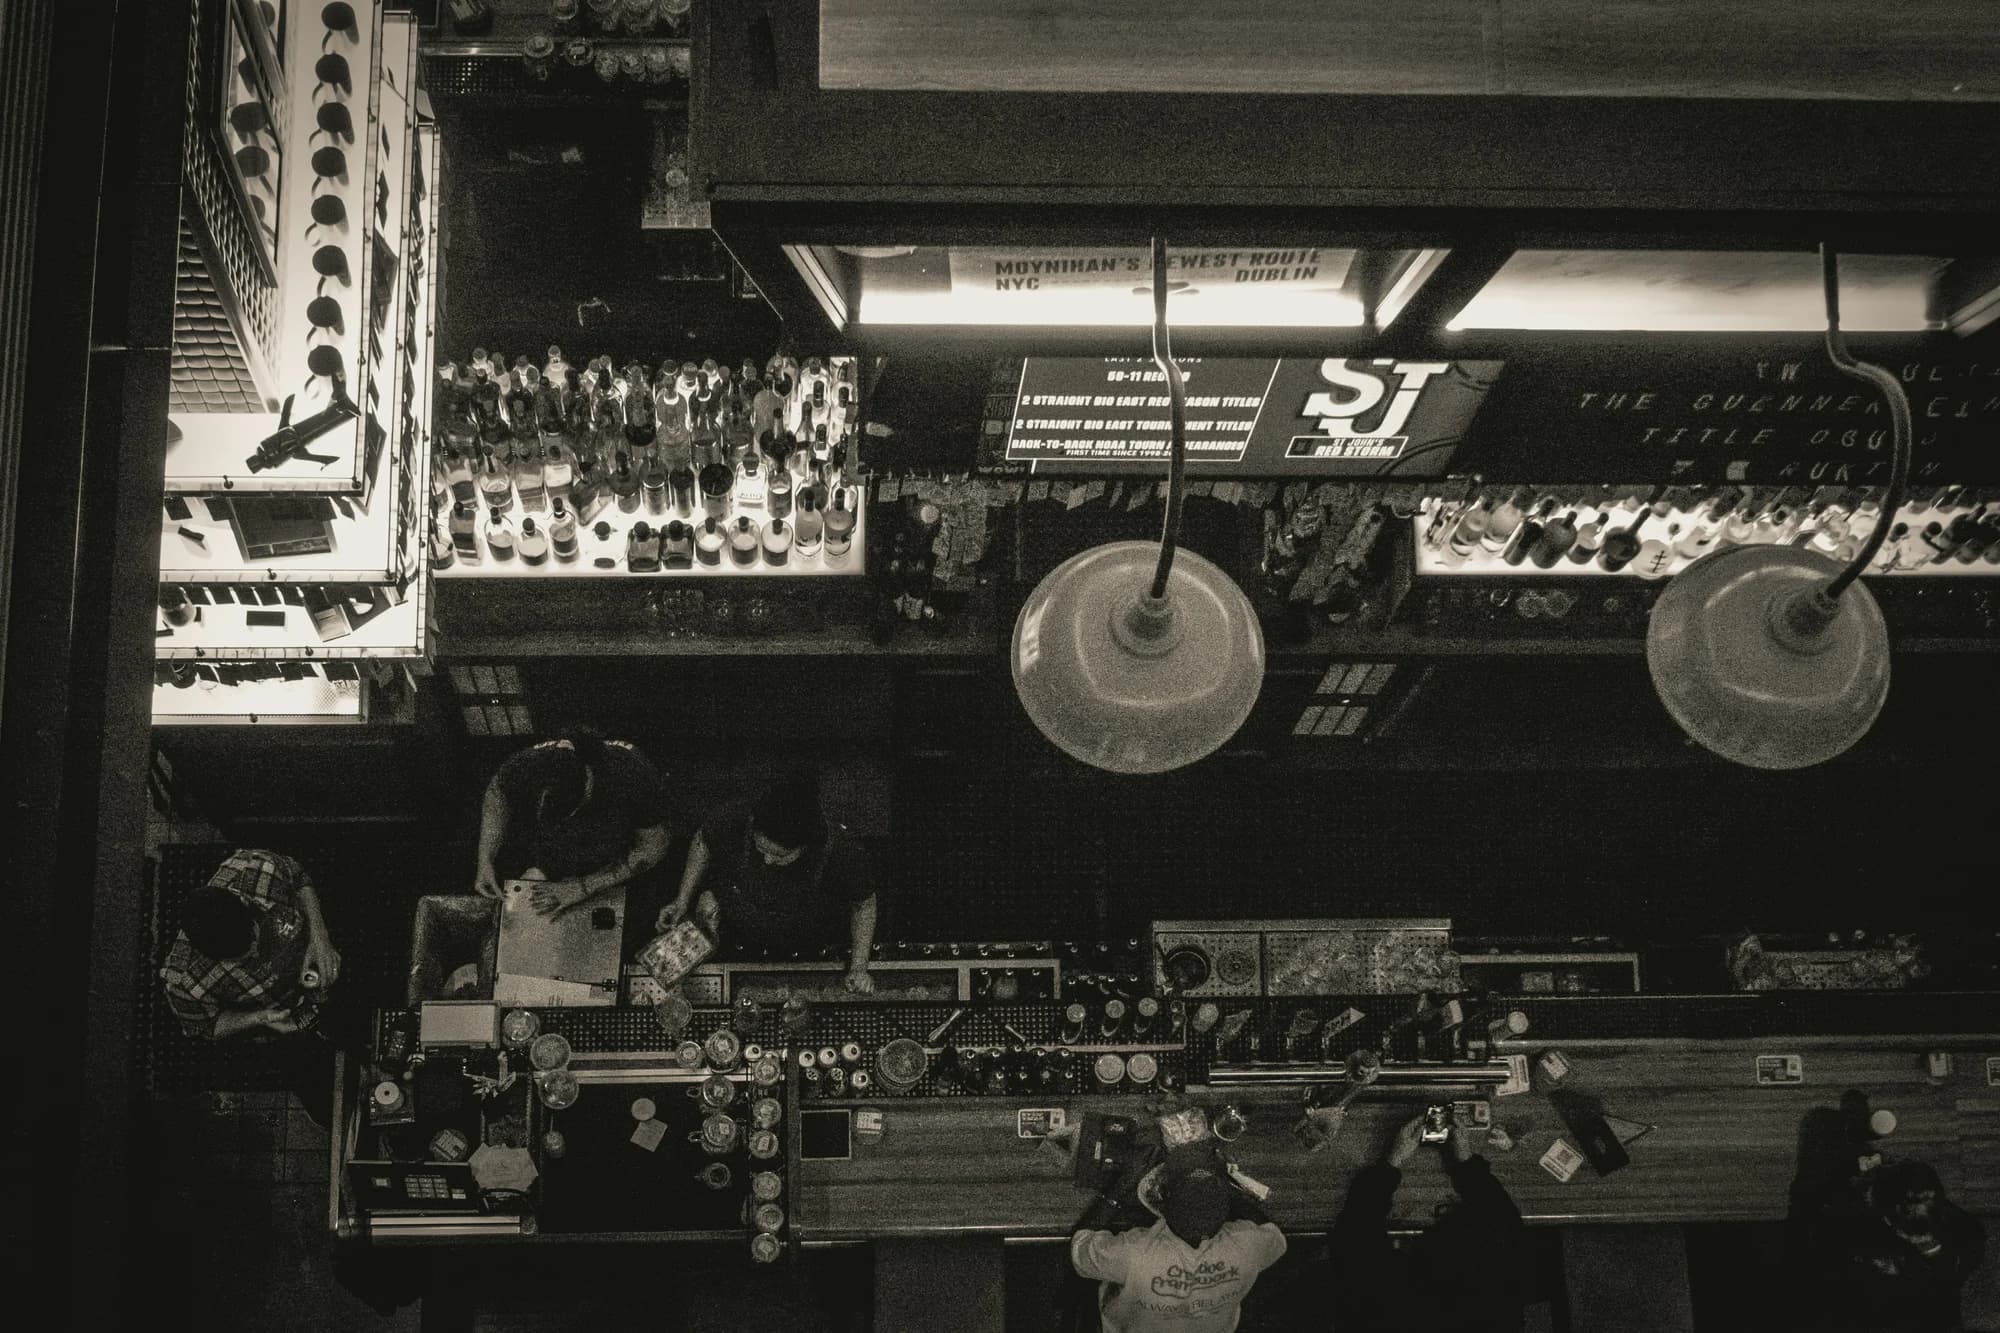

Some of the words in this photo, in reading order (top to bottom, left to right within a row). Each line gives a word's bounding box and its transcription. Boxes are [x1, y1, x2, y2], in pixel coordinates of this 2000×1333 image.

[995, 257, 1140, 275] MOYNIHAN'S
[1149, 252, 1242, 270] EWEST
[1249, 249, 1321, 267] ROUTE
[996, 277, 1040, 291] NYC
[1235, 266, 1318, 283] DUBLIN
[1142, 371, 1192, 383] RECD
[1021, 395, 1031, 406] 2
[1033, 395, 1092, 407] STRAIGHT
[1093, 396, 1115, 407] BIG
[1116, 396, 1146, 407] EAST
[1182, 396, 1221, 408] ASON
[1221, 397, 1262, 408] TITLES
[1580, 393, 1657, 410] THE
[1015, 419, 1025, 430] 2
[1026, 419, 1083, 430] STRAIGHT
[1083, 420, 1105, 430] BIG
[1105, 420, 1134, 431] EAST
[1136, 420, 1215, 431] TOURNMENT
[1216, 421, 1253, 432] TITLES
[1332, 438, 1345, 447] ST
[1347, 438, 1385, 447] JOHN'S
[1642, 427, 1775, 445] TITLE
[1011, 439, 1094, 450] BACK-TO-BACK
[1095, 440, 1126, 450] NCAA
[1128, 440, 1166, 450] TOURN
[1166, 440, 1246, 451] AEARANCES
[1314, 446, 1342, 457] RED
[1344, 446, 1396, 457] STORM
